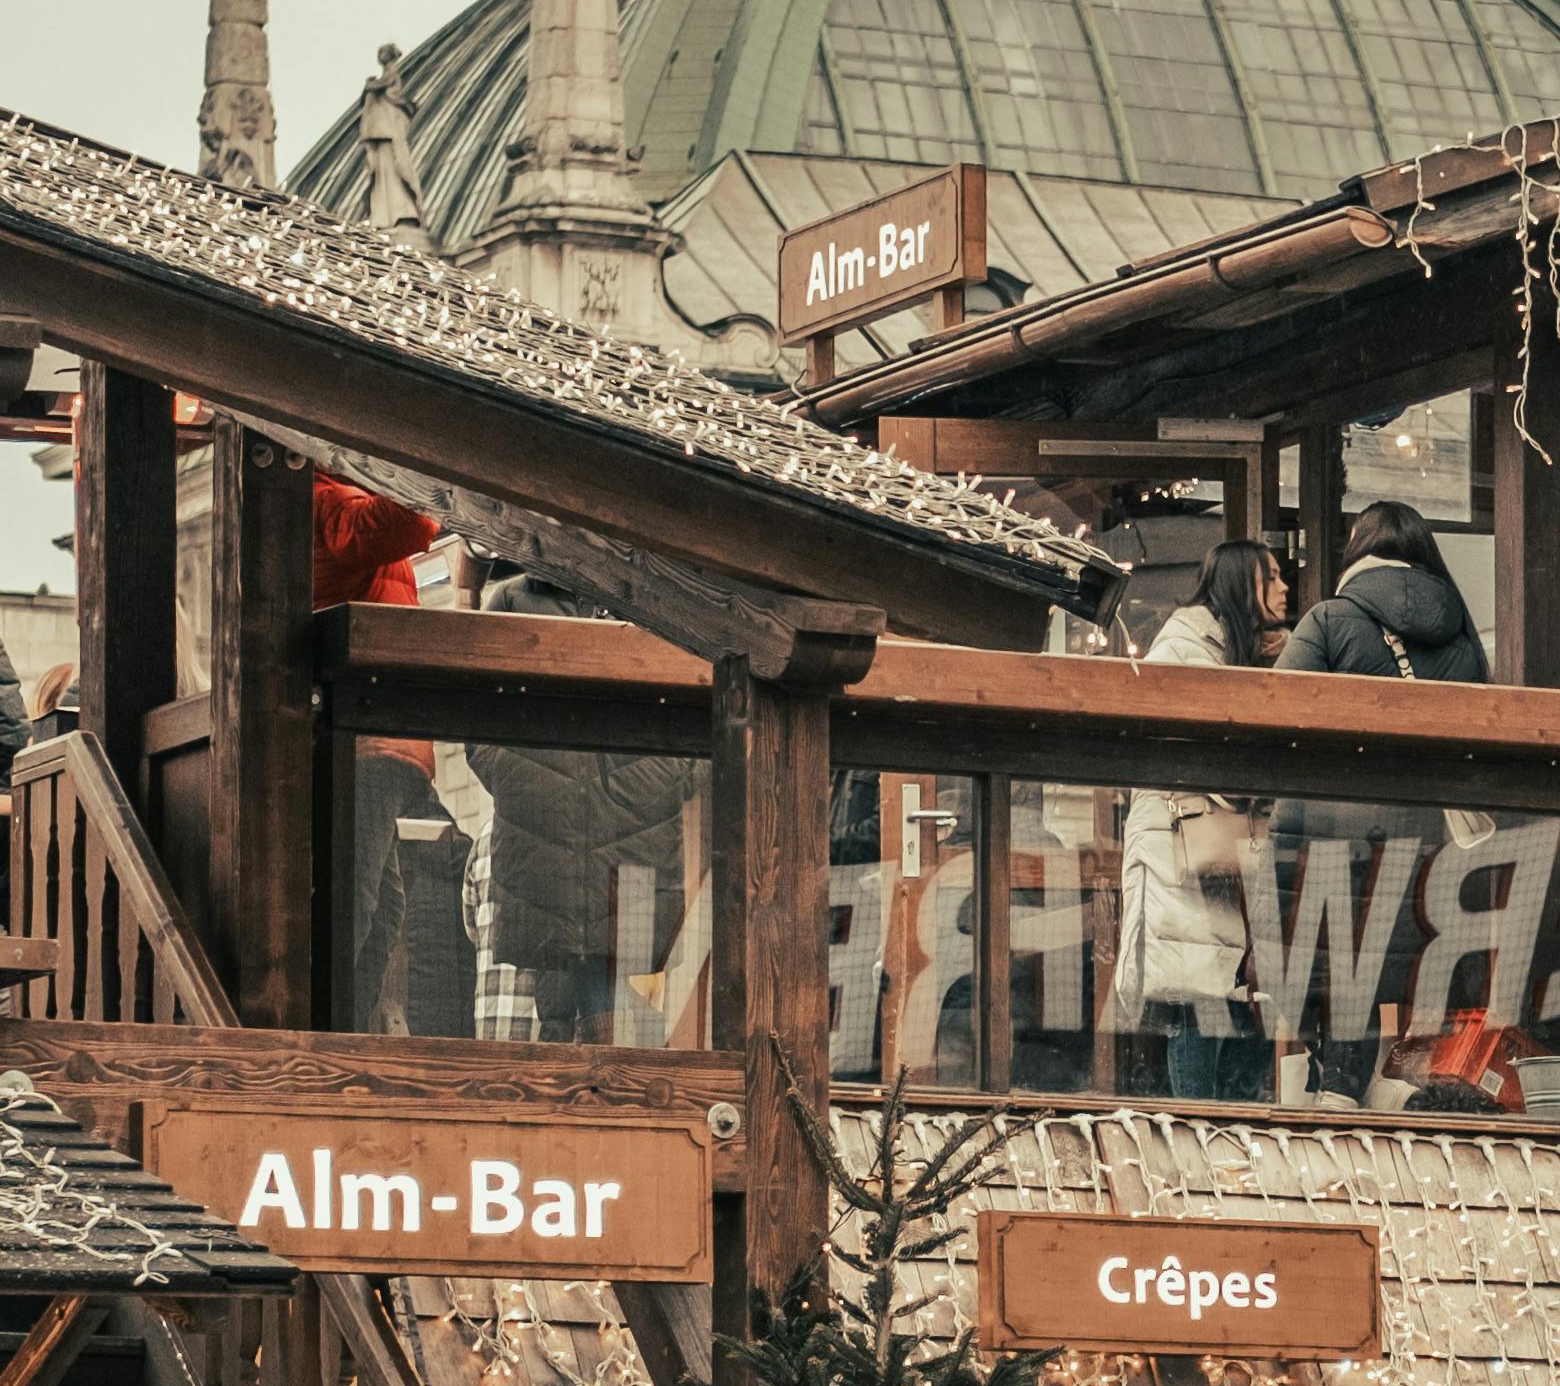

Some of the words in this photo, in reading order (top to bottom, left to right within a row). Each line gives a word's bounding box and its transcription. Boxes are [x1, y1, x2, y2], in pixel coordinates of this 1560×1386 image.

[806, 220, 932, 307] Alm-Bar
[240, 1148, 621, 1239] Alm-Bar
[1097, 1255, 1278, 1321] Crêpes
